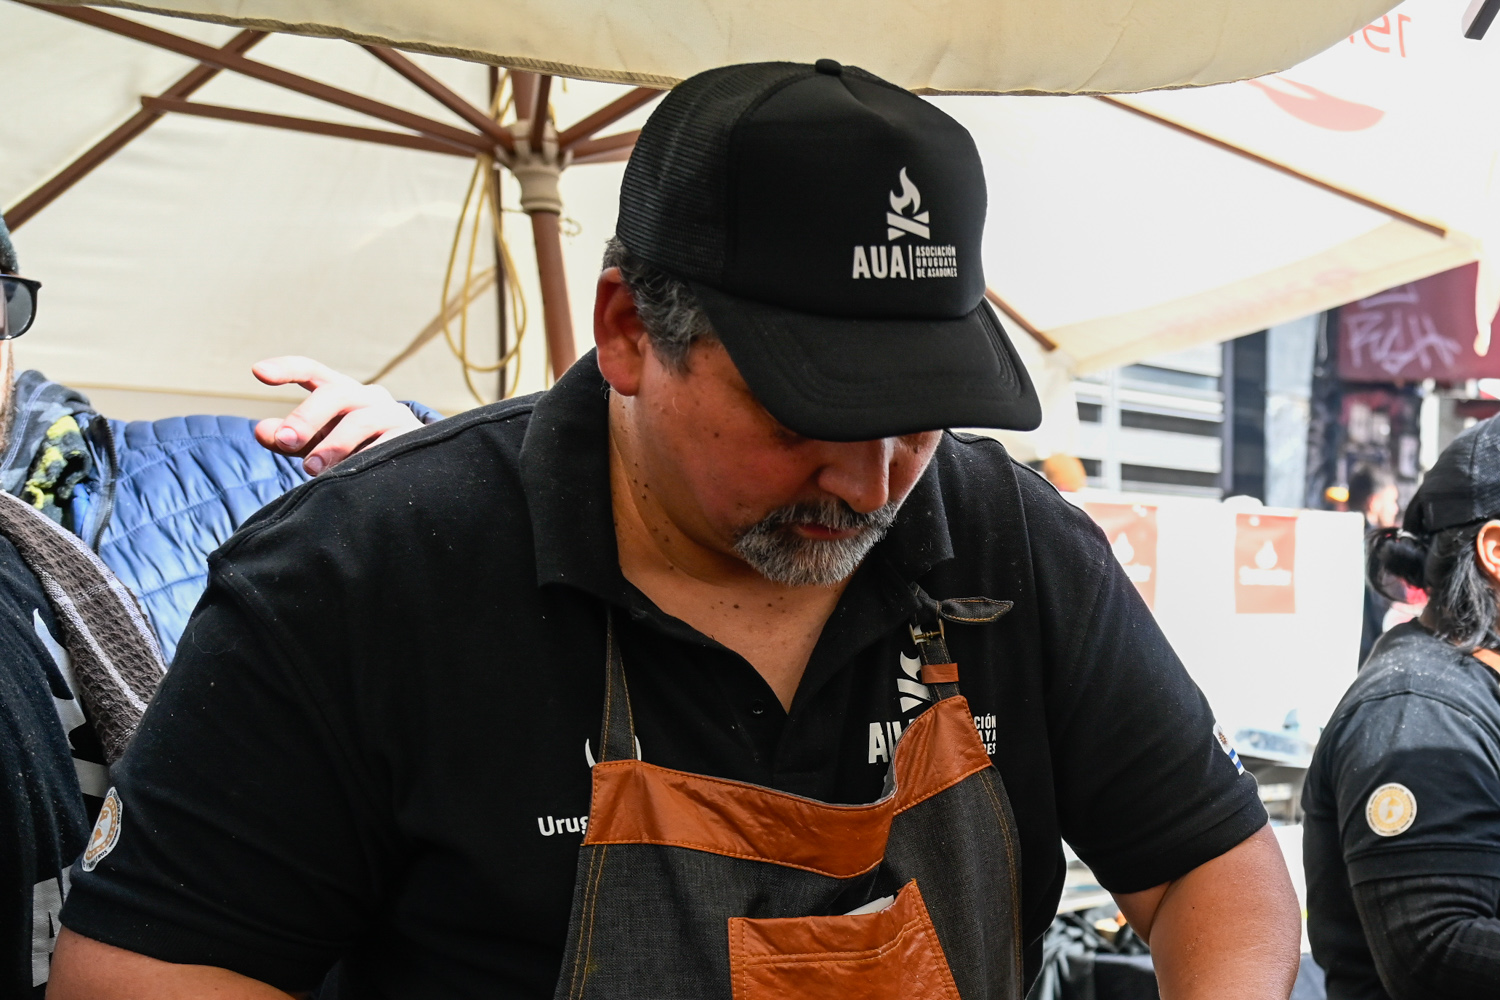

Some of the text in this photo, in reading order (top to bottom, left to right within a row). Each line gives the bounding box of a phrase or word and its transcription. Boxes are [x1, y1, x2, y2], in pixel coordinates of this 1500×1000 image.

[915, 244, 956, 257] ASOCIACIÓN
[852, 245, 907, 279] AUA
[915, 257, 957, 267] URUGUAYA
[916, 267, 958, 278] DE ASADORES
